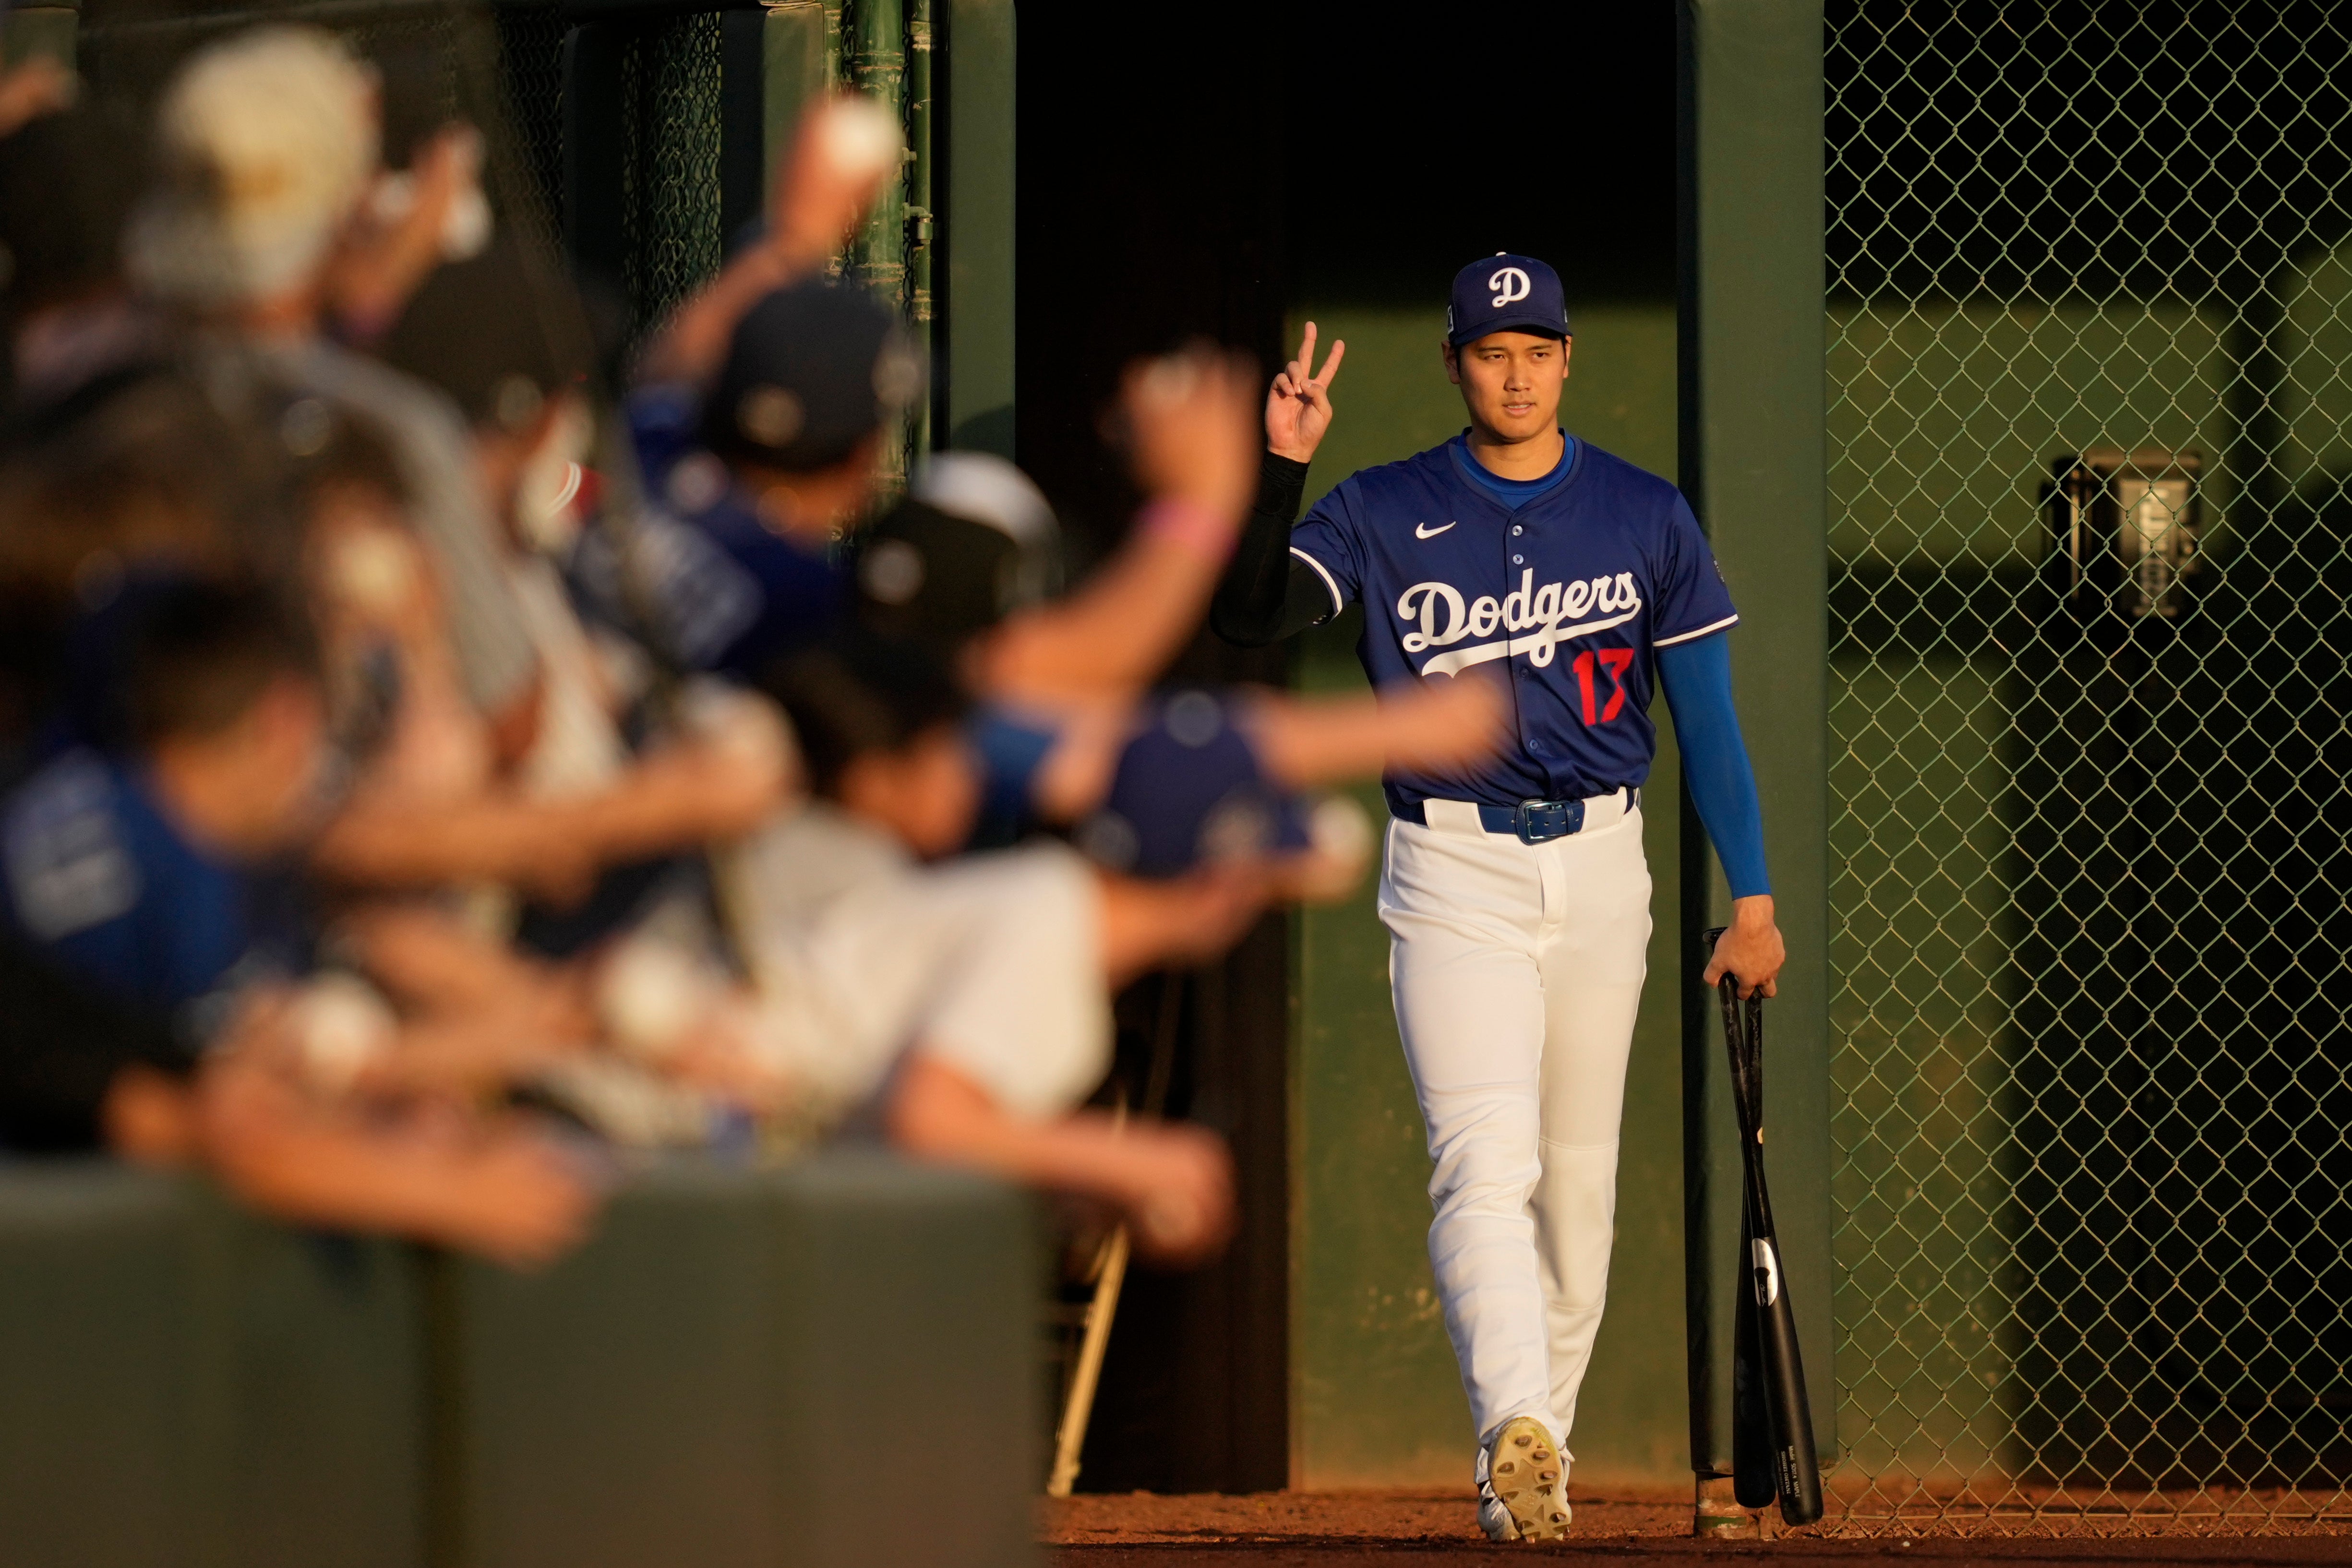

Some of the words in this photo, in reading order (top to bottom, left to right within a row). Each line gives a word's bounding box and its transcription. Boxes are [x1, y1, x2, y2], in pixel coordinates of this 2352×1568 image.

[1488, 267, 1530, 308] D
[1398, 568, 1642, 677] Dodgers
[1572, 648, 1634, 726] 17
